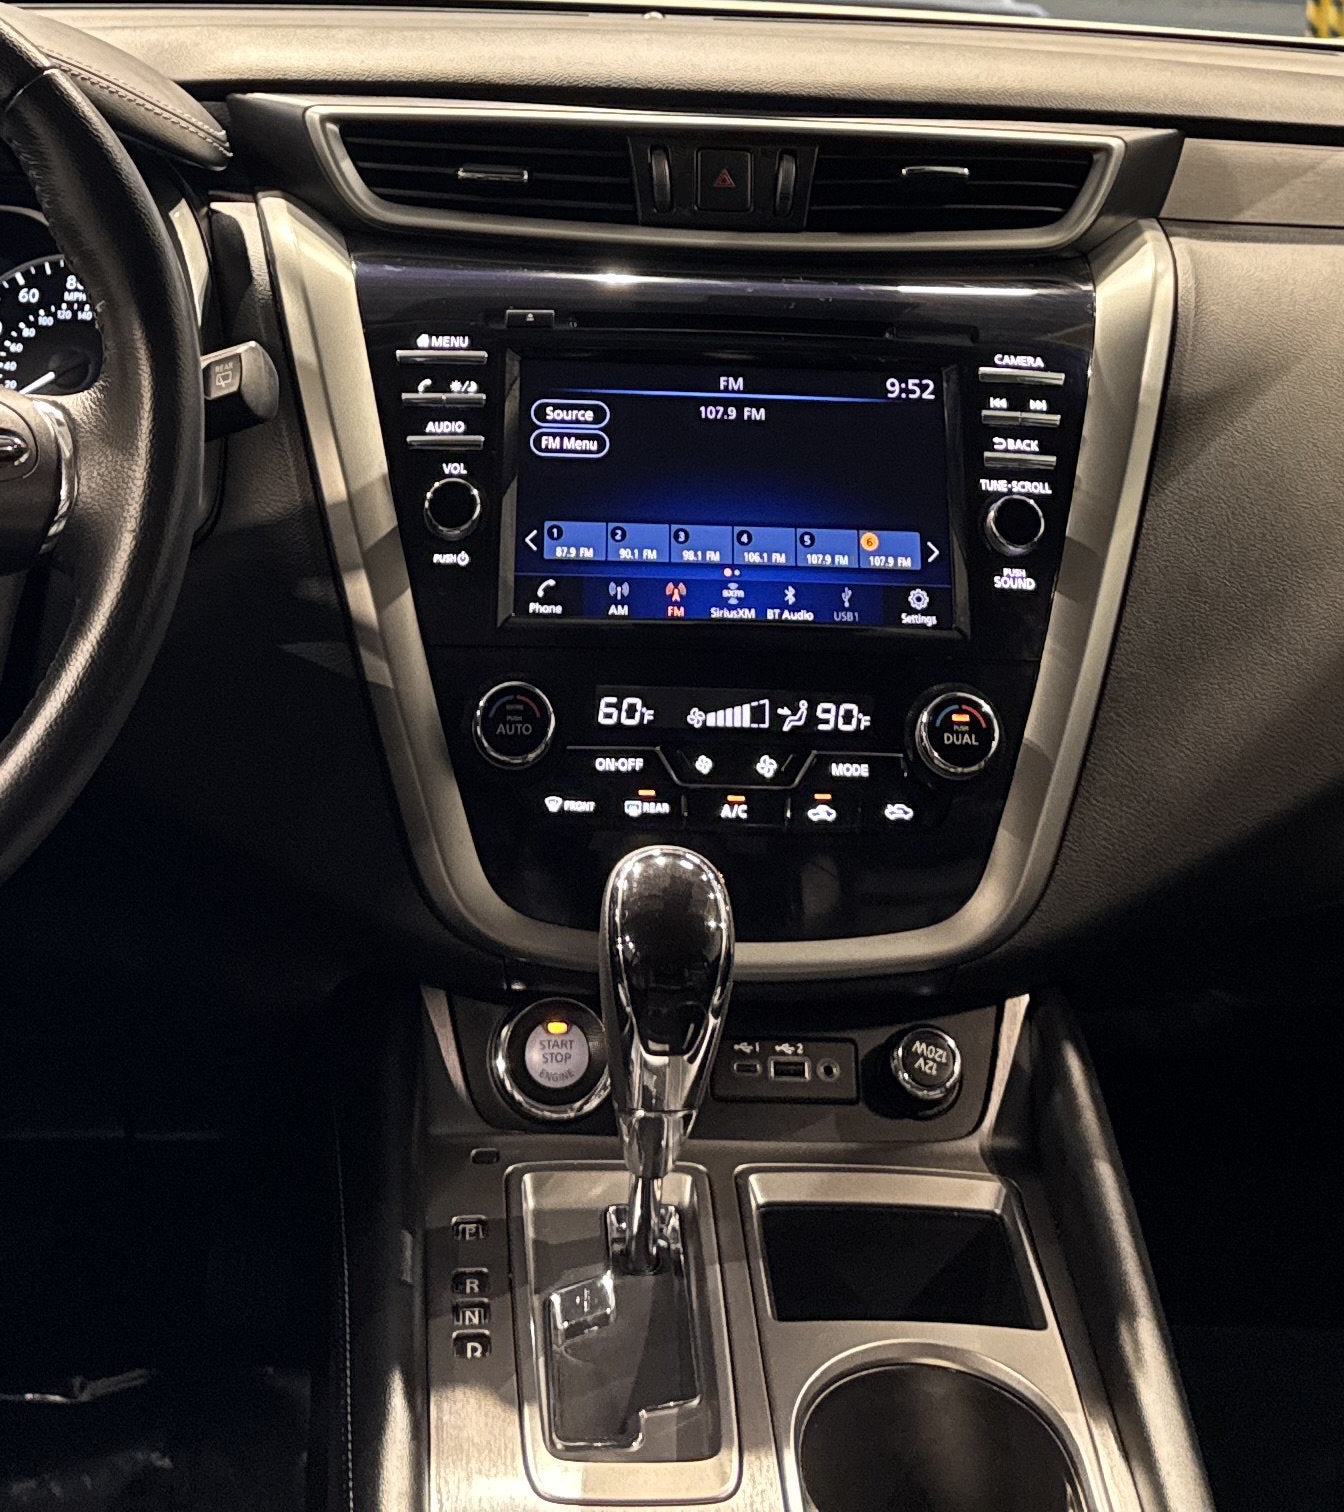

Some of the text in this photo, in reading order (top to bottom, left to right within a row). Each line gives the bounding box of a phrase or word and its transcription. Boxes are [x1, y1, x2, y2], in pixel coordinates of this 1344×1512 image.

[18, 288, 40, 303] 60
[63, 291, 87, 302] MPH
[431, 335, 469, 348] MENU
[993, 354, 1045, 368] CAMERA
[719, 376, 744, 391] FM
[885, 377, 936, 400] 9:52
[545, 406, 595, 422] Source
[699, 405, 766, 421] 107.9 FM
[425, 420, 466, 433] AUDIO
[541, 436, 598, 451] FM Menu
[1007, 438, 1040, 452] BACK
[442, 462, 468, 475] VOL
[551, 527, 558, 538] 1
[615, 529, 622, 540] 2
[678, 531, 685, 542] 3
[740, 533, 748, 544] 4
[803, 534, 811, 545] 5
[866, 537, 873, 547] 6
[555, 546, 594, 558] 87.9 FM
[618, 548, 657, 560] 90.1 FM
[682, 549, 721, 562] 98.1 FM
[743, 551, 786, 563] 106.1 FM
[806, 553, 849, 566] 107.9 FM
[869, 555, 912, 568] 107.9 FM
[993, 576, 1036, 590] SOUND
[528, 602, 563, 614] Phone
[608, 605, 629, 616] AM
[667, 605, 685, 617] FM
[710, 607, 755, 619] SiriusXM
[766, 608, 814, 621] BT Audio
[901, 612, 937, 627] Settings
[495, 723, 533, 736] AUTO
[943, 732, 979, 746] DUAL
[831, 762, 869, 778] MODE
[563, 800, 596, 812] FRONT
[642, 802, 670, 814] REAR
[720, 803, 748, 819] A/C
[539, 1039, 574, 1050] START
[542, 1052, 572, 1063] STOP
[911, 1040, 947, 1064] 120W
[914, 1057, 938, 1075] 12V
[538, 1068, 575, 1082] ENGINE
[465, 1224, 477, 1240] P
[465, 1278, 479, 1294] R
[465, 1310, 479, 1325] N
